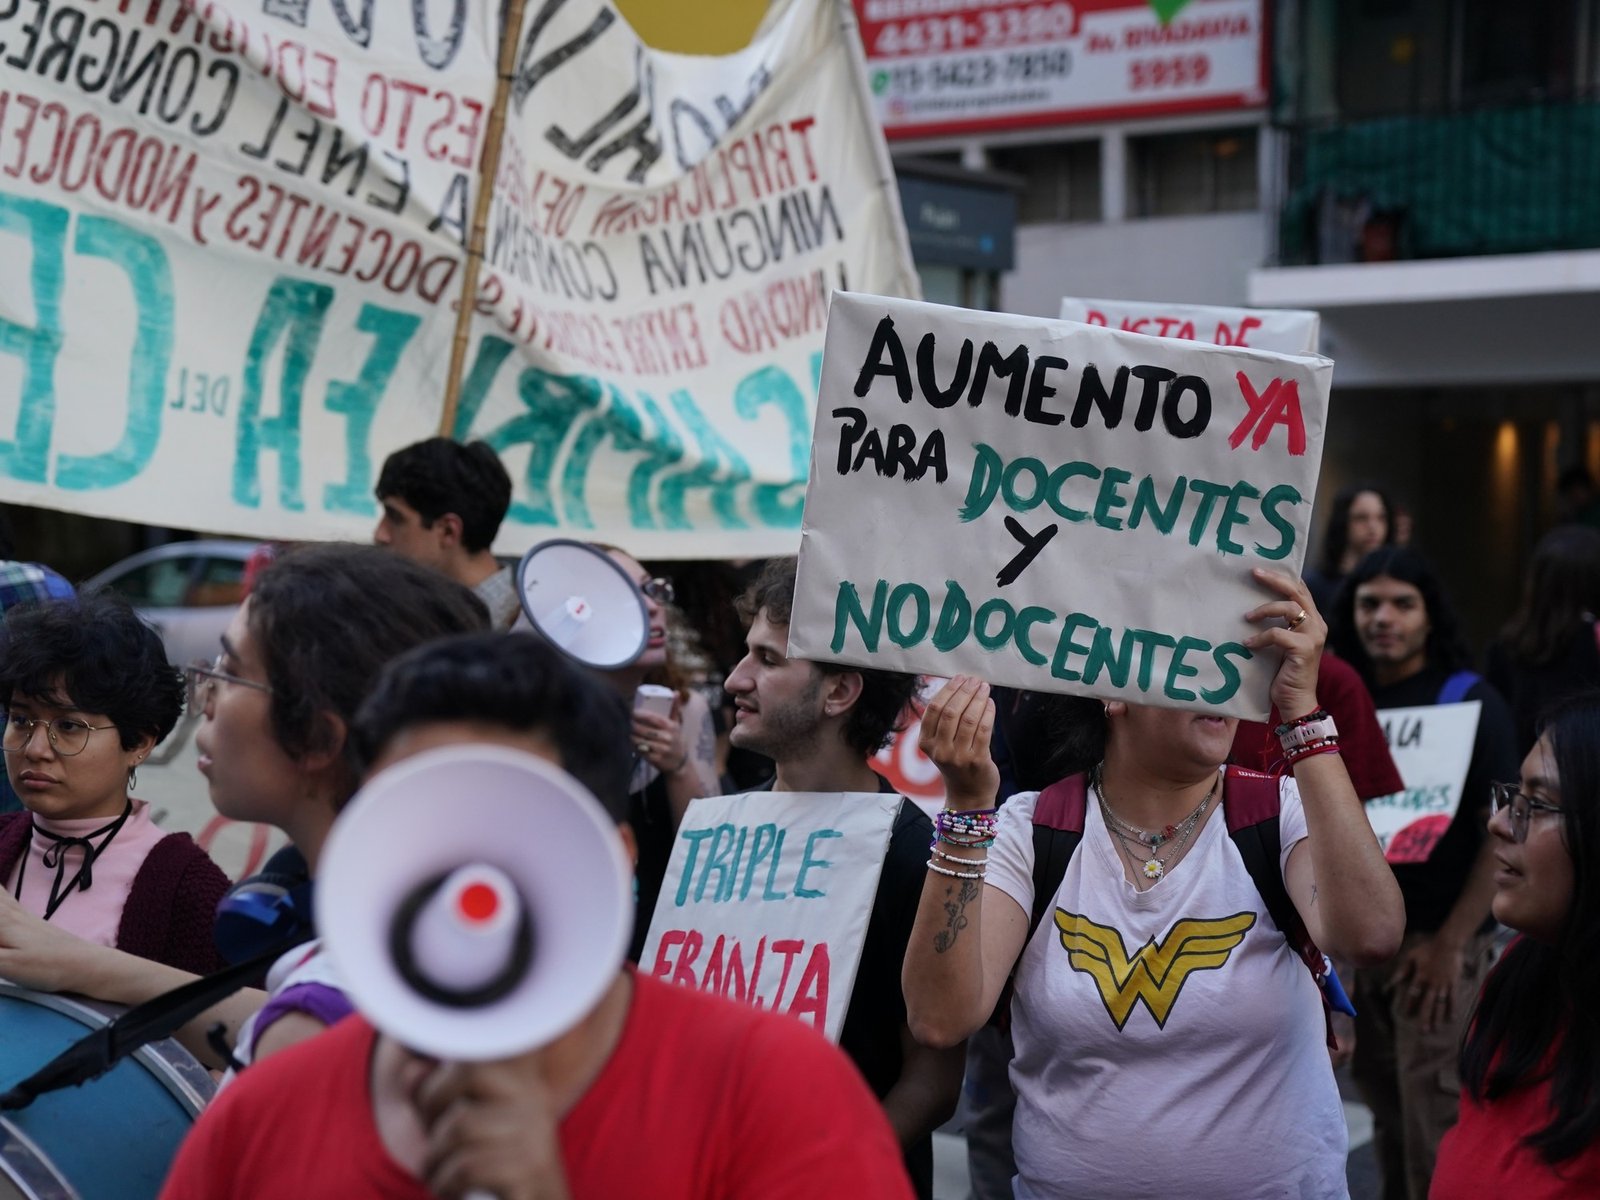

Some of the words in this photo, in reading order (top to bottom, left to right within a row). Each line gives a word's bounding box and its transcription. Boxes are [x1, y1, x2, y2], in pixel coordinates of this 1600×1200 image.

[854, 314, 1212, 439] AUMENTO
[1228, 370, 1307, 457] YA
[832, 407, 949, 484] PARA
[957, 442, 1303, 561] DOCENTES
[995, 515, 1058, 587] Y
[830, 579, 1254, 704] NODOCENTES
[674, 822, 844, 908] TRIPLE
